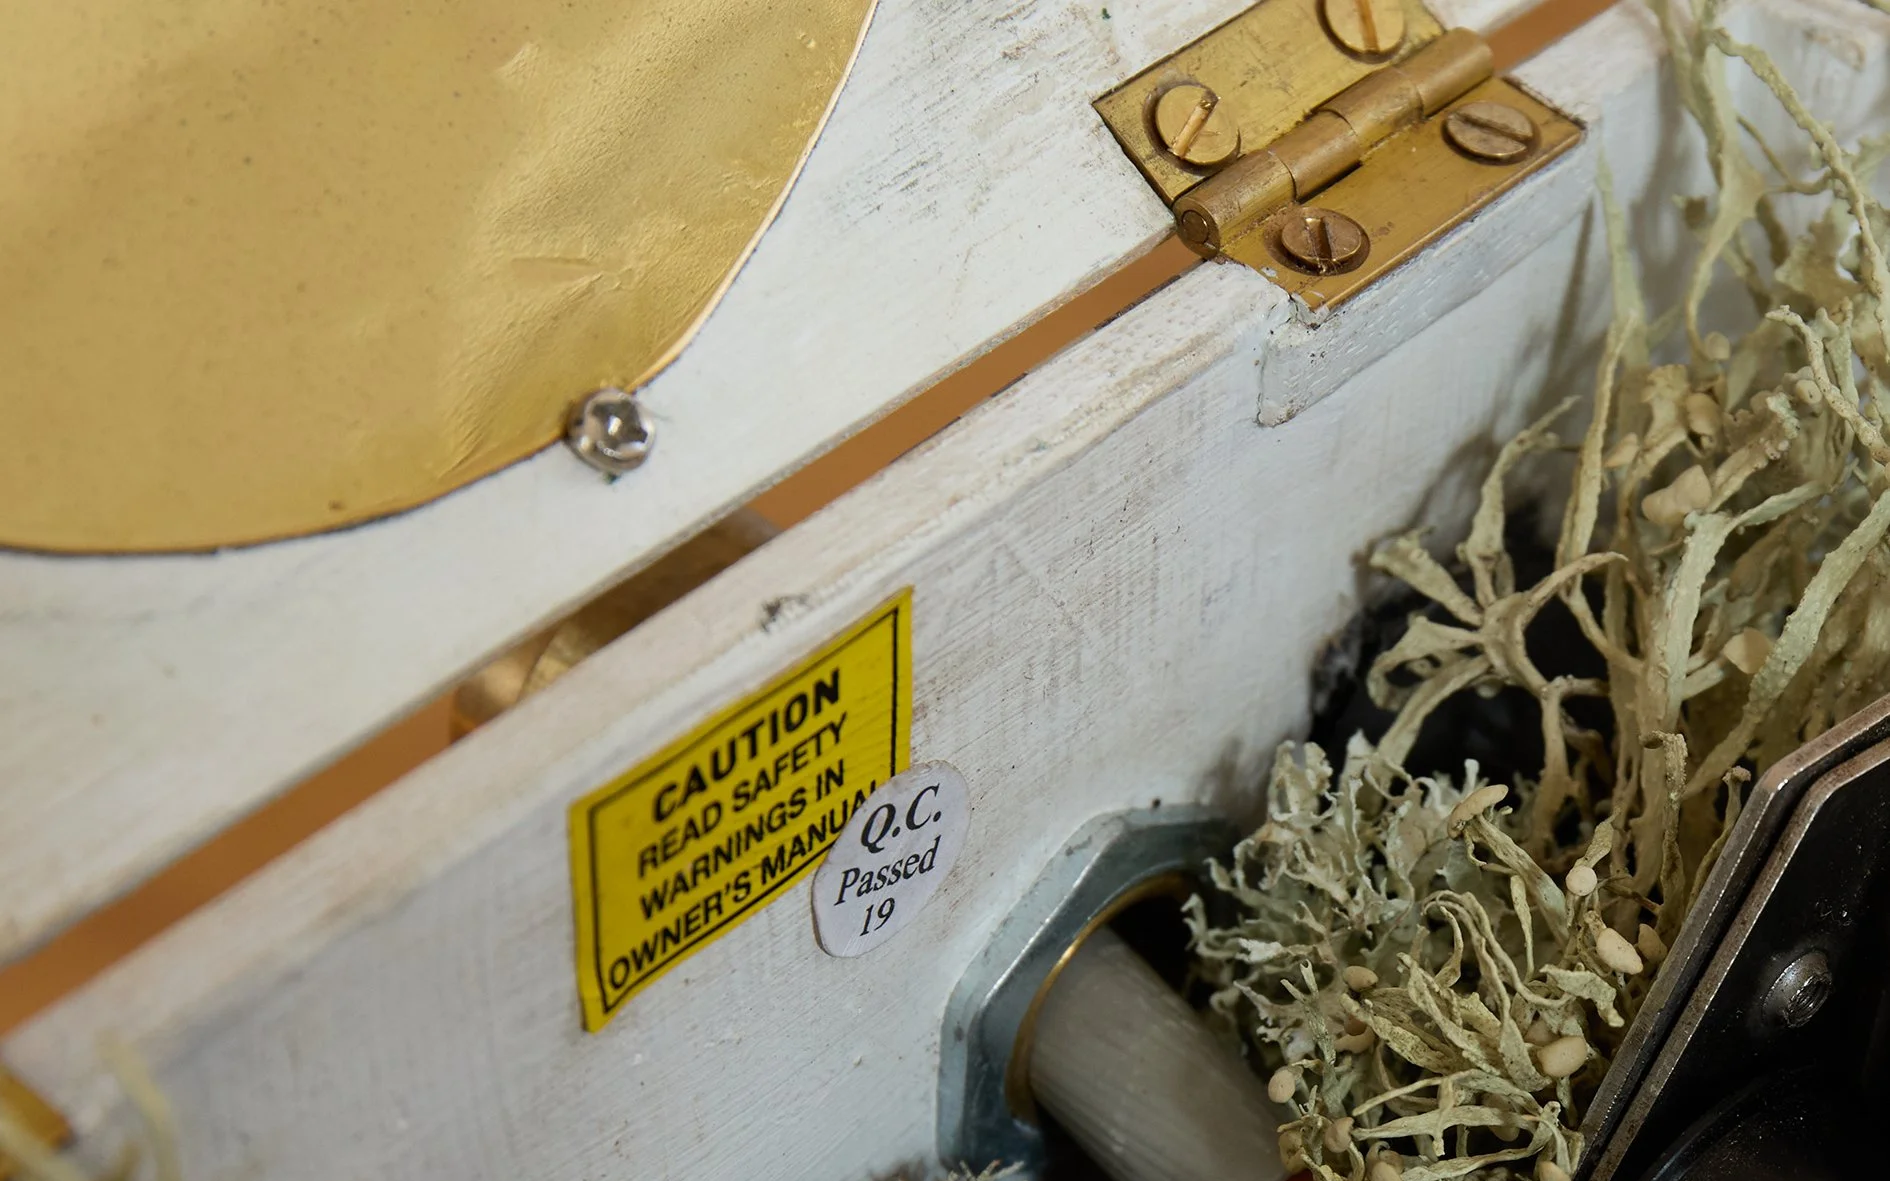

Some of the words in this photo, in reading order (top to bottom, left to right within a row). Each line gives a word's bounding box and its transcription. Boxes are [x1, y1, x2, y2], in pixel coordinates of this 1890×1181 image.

[638, 800, 723, 878] READ
[732, 713, 849, 812] SAFETY
[652, 668, 840, 824] CAUTION
[640, 787, 808, 921] WARNINGS
[816, 758, 845, 804] IN
[834, 835, 942, 907] Passed
[861, 782, 942, 855] Q.C.
[608, 870, 752, 992] OWNER'S
[859, 897, 896, 938] 19
